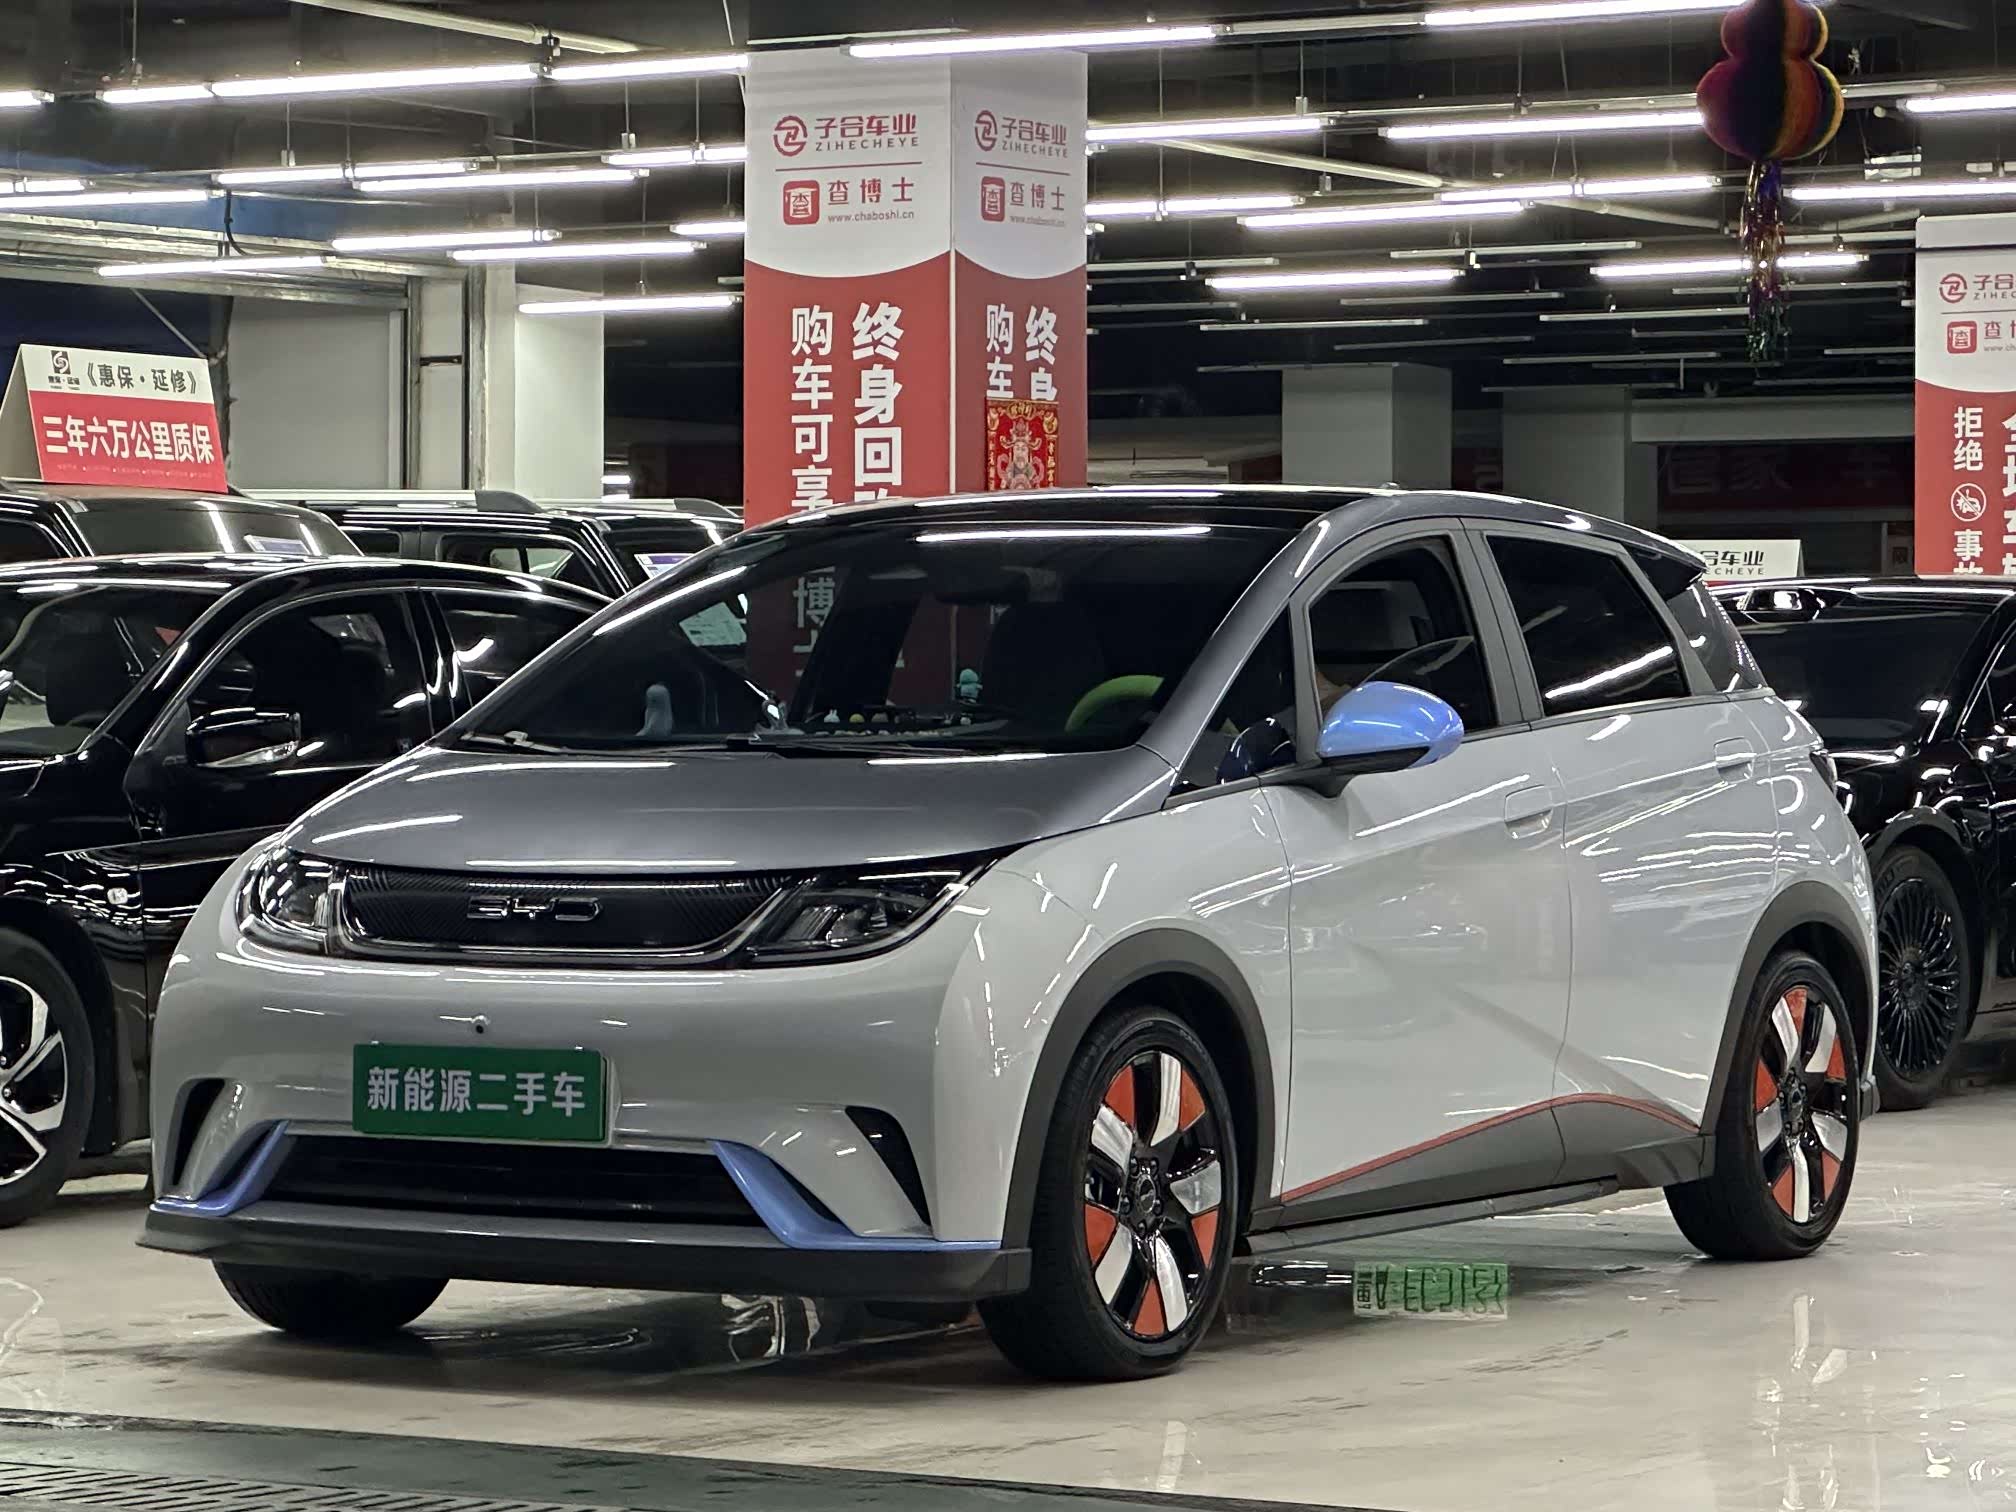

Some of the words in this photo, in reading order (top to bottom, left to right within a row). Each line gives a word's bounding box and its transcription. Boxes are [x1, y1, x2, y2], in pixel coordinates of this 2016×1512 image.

[814, 113, 917, 139] 子合车业
[1001, 116, 1067, 146] 子合车业
[815, 137, 919, 152] ZIHECHEYE
[1002, 140, 1069, 158] ZIHECHEYE
[827, 176, 915, 206] 查博士
[1009, 181, 1066, 211] 查博士
[828, 210, 915, 223] www.chaboshi.cn
[986, 303, 1014, 399] 购车
[791, 304, 834, 511] 购车可享
[852, 302, 904, 500] 终身回
[42, 414, 216, 465] 三年六万公里质保
[1953, 406, 1984, 472] 拒绝
[466, 895, 600, 921] BYD
[367, 1066, 586, 1117] 新能源二手车
